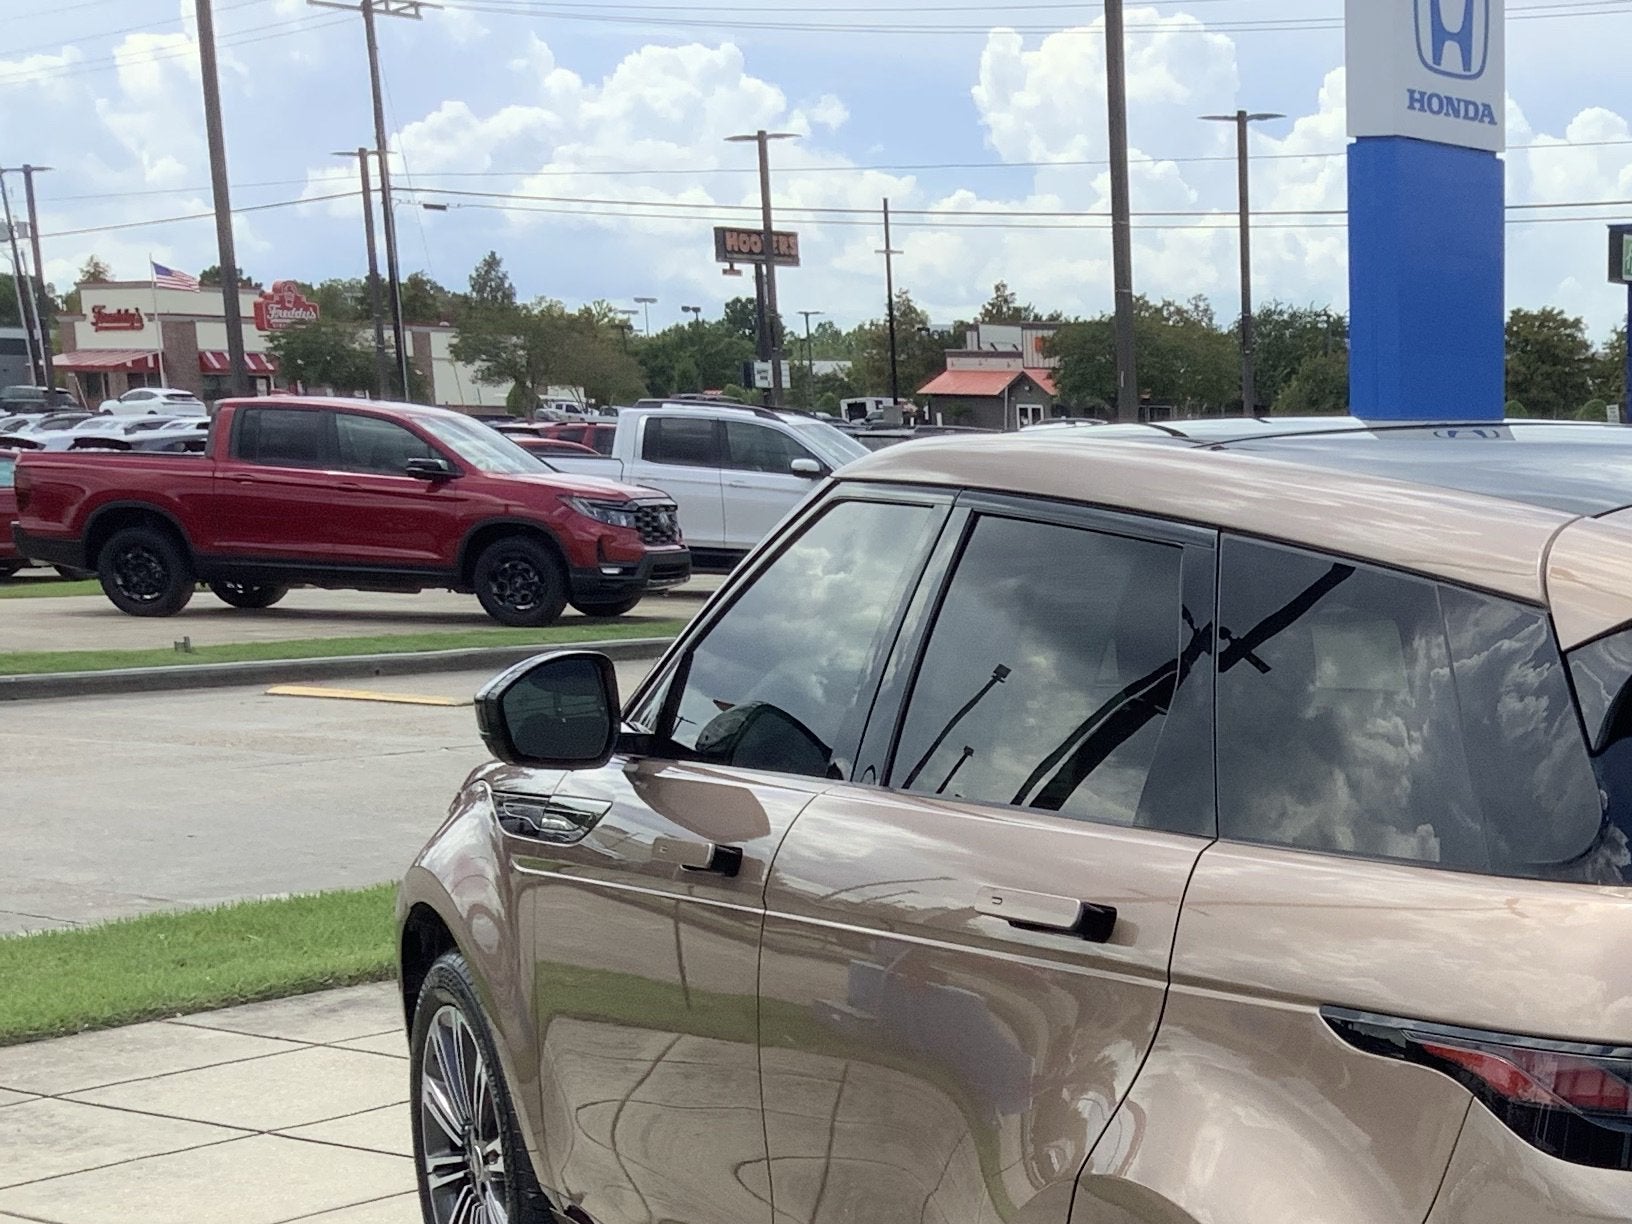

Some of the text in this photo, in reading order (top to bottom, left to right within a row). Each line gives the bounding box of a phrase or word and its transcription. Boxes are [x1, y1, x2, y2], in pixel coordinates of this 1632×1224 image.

[1406, 88, 1498, 126] HONDA
[725, 231, 798, 255] HOOERS
[266, 303, 316, 320] Freddy's
